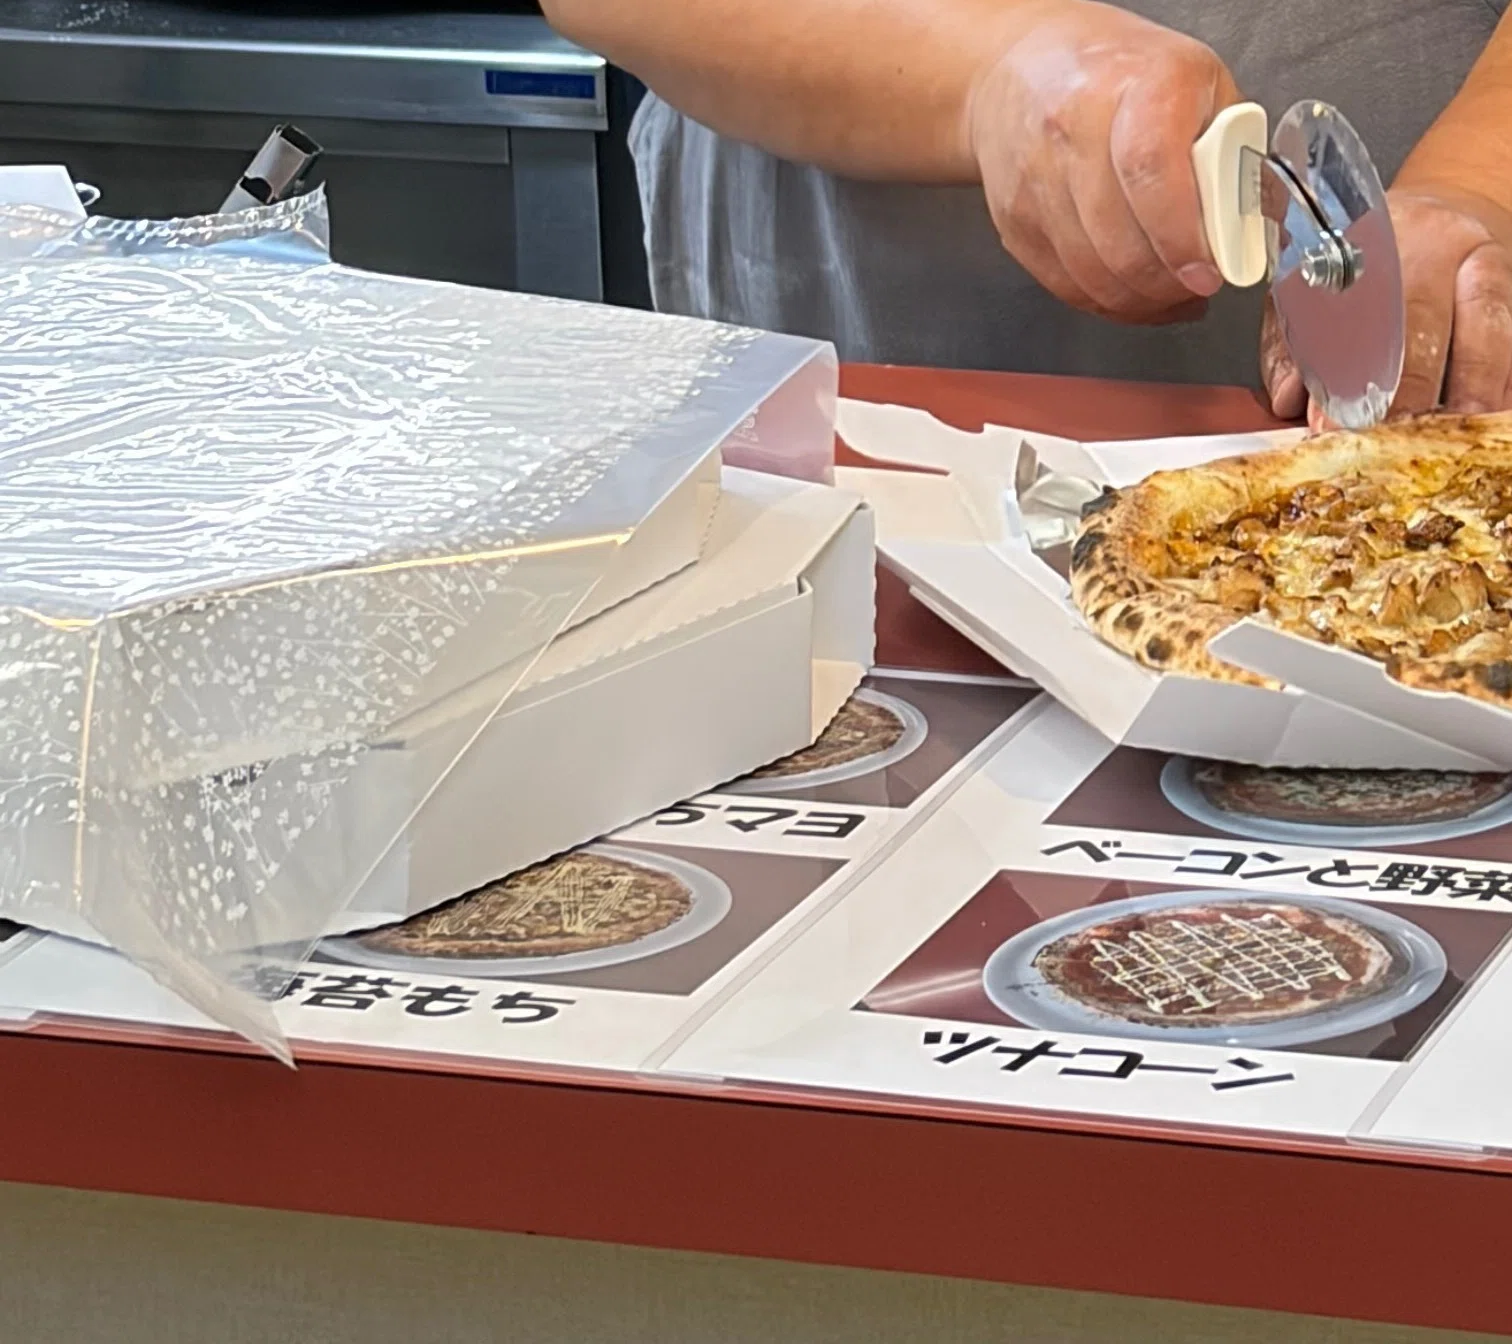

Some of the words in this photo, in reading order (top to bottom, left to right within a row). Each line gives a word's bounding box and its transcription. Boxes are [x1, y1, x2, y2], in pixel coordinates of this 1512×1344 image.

[922, 1030, 1296, 1091] ツナコーン
